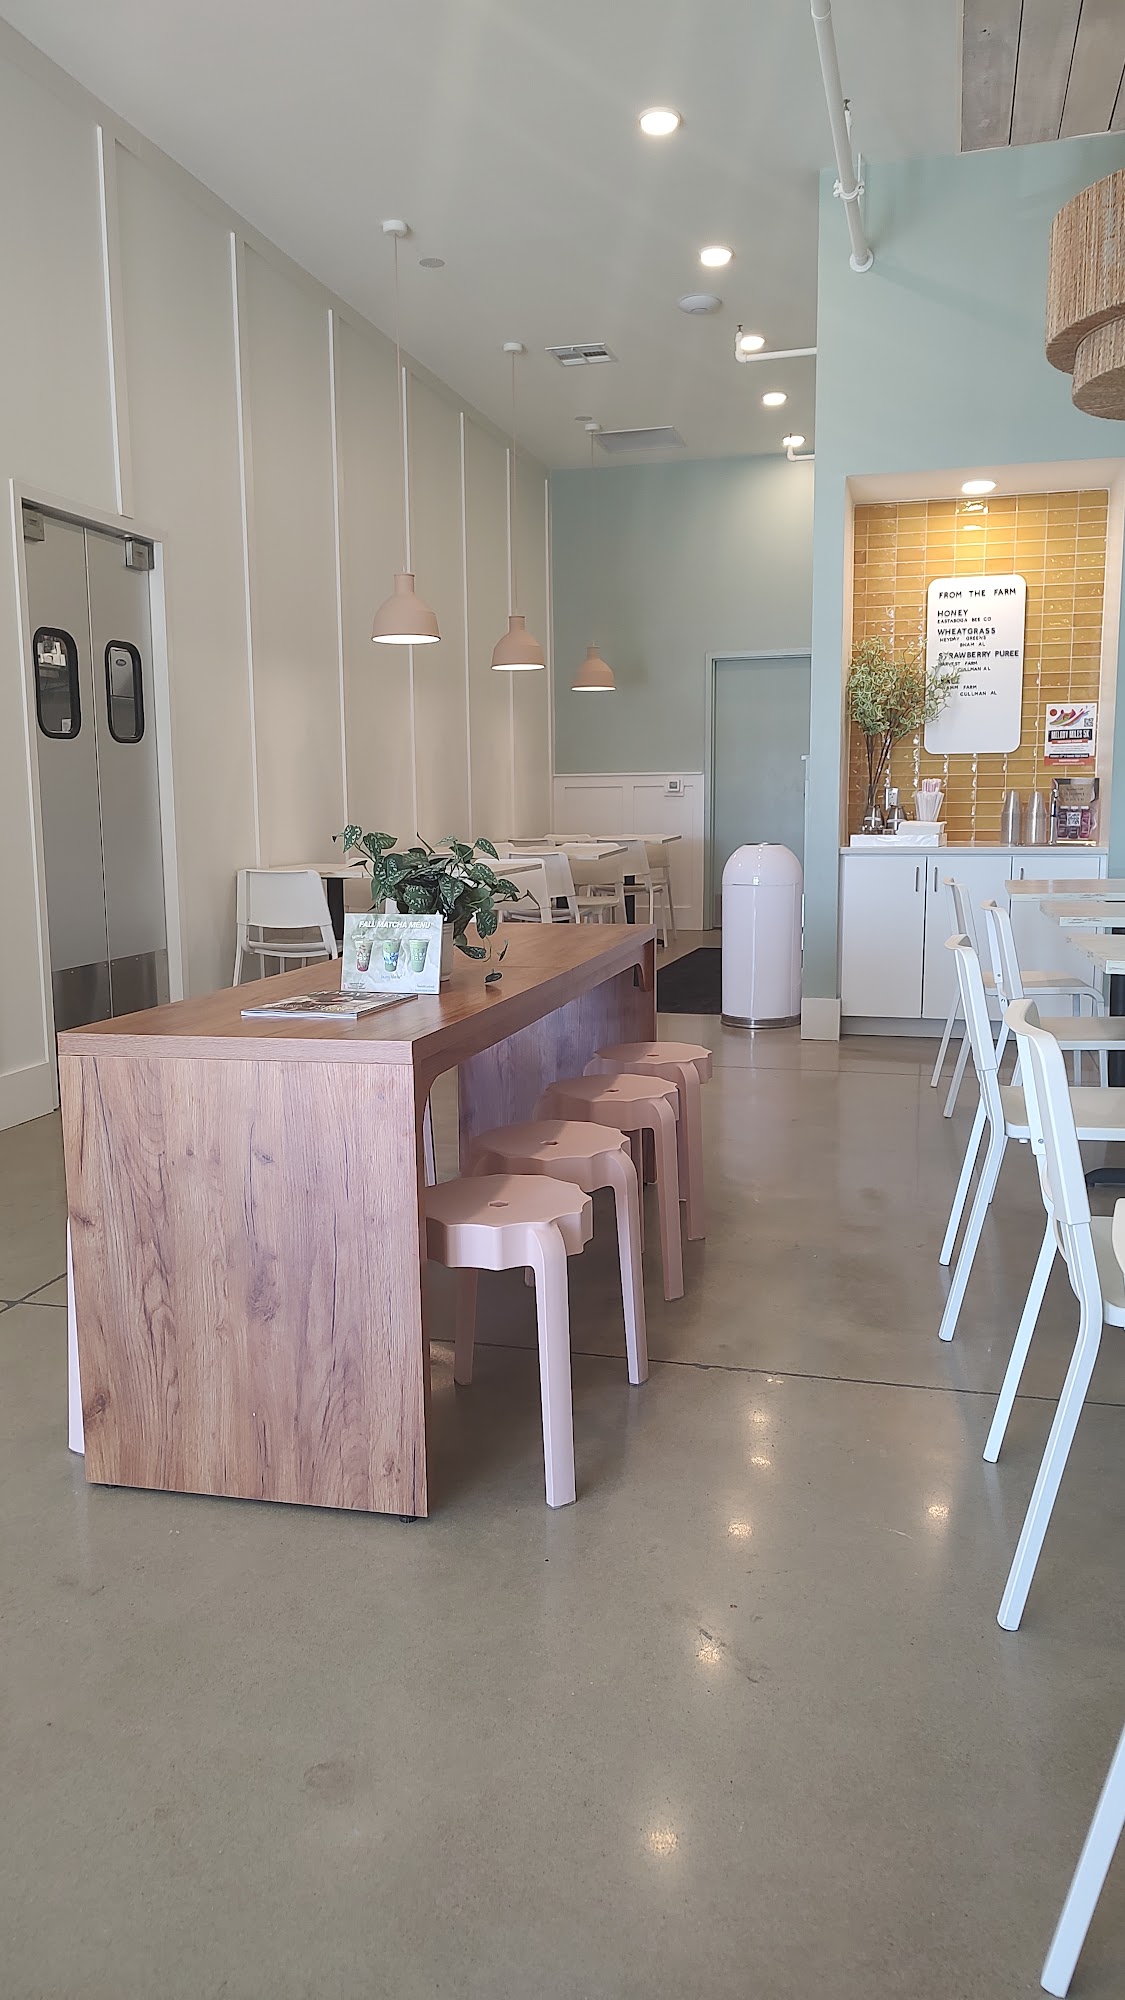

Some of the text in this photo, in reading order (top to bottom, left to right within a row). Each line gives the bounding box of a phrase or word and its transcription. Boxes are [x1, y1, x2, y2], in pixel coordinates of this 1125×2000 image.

[938, 588, 1017, 599] FROM THE FARM
[937, 609, 969, 617] HONEY
[937, 627, 996, 636] WHEATGRASS
[994, 649, 1019, 657] PUREE
[359, 920, 431, 929] FALL MATCHA MENU
